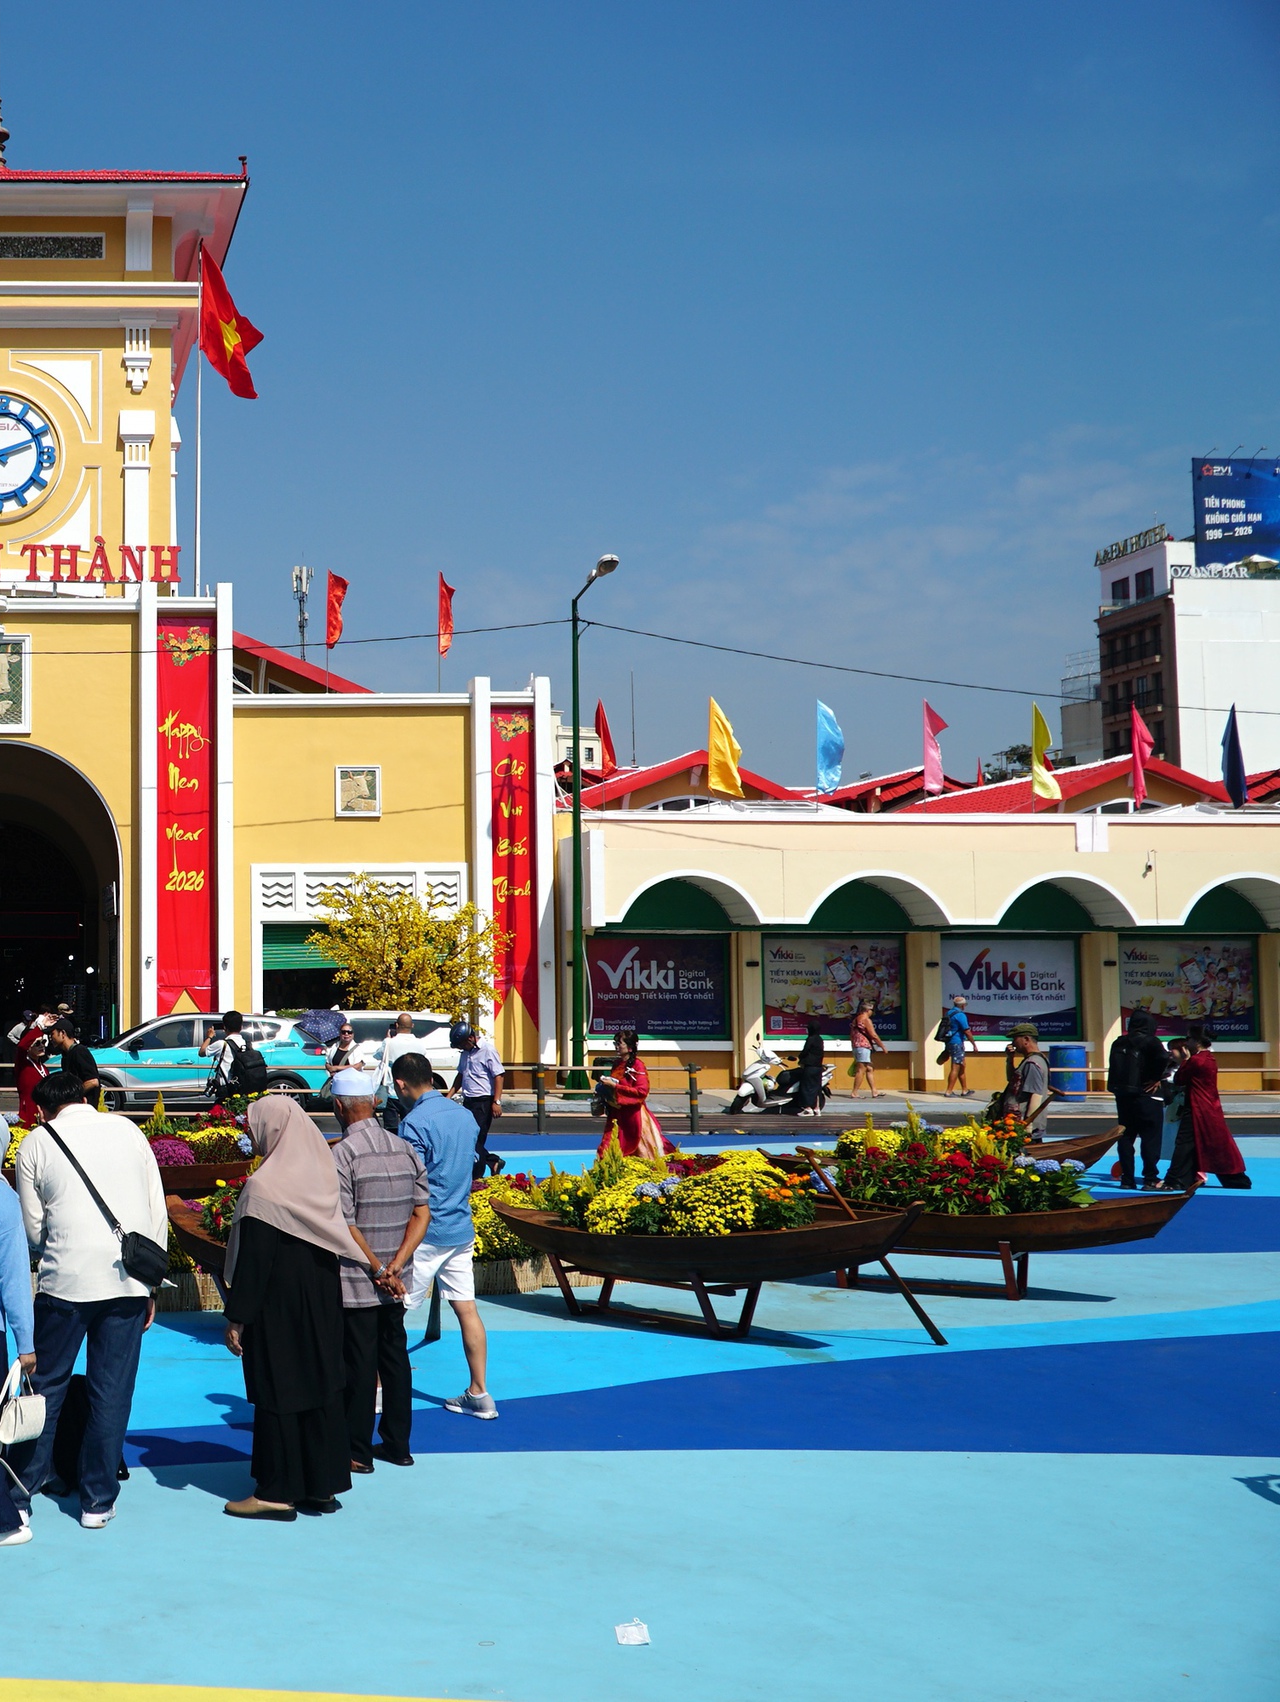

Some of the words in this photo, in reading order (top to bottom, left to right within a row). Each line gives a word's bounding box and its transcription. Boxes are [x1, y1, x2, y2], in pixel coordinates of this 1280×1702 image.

[1222, 499, 1246, 508] PHONG
[1205, 511, 1230, 524] KHÔNG
[1248, 513, 1262, 524] HẠN
[1206, 529, 1222, 540] 1996
[1234, 526, 1252, 536] 2026
[20, 536, 182, 582] THÀNH
[1170, 566, 1220, 578] OZONE
[1222, 566, 1250, 578] BAR
[158, 708, 212, 759] Happy
[494, 758, 526, 780] Chợ
[500, 794, 522, 818] Vui
[496, 836, 528, 857] Bến
[165, 869, 204, 891] 2026
[493, 876, 531, 903] Thành
[769, 946, 794, 960] Vikki
[1124, 947, 1147, 960] Vikki
[597, 946, 674, 989] Vikki
[679, 969, 705, 978] Digital
[948, 948, 1026, 990] Vikki
[1030, 970, 1057, 980] Digital
[679, 978, 714, 989] Bank
[1031, 980, 1065, 990] Bank
[597, 992, 618, 1001] Ngân
[620, 992, 639, 1001] hàng
[641, 992, 657, 1001] Tiết
[659, 992, 677, 1001] kiệm
[679, 992, 692, 1001] Tốt
[694, 992, 714, 1001] nhất!
[972, 993, 990, 1001] hàng
[993, 993, 1008, 1001] Tiết
[1010, 993, 1028, 1001] kiệm
[1031, 993, 1043, 1001] Tốt
[1045, 993, 1066, 1001] nhất!
